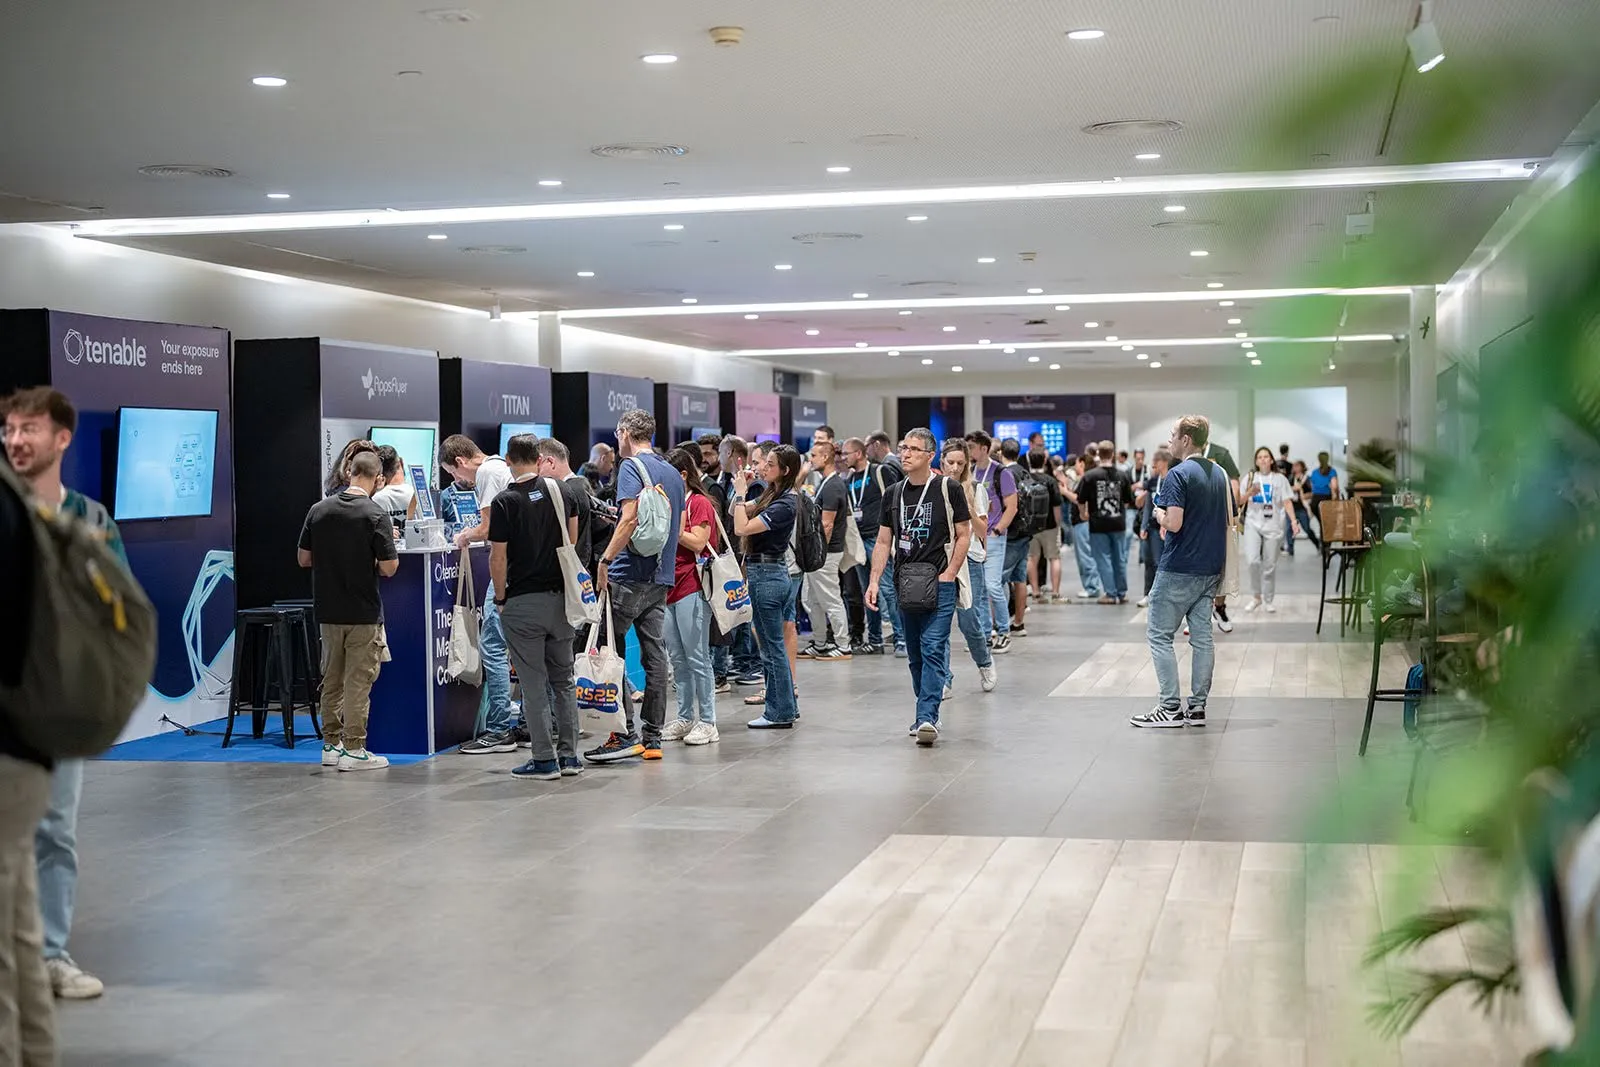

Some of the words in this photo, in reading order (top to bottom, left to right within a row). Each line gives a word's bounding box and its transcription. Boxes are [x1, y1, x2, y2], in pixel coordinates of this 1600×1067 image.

[84, 335, 147, 367] tenable
[161, 340, 180, 355] Your
[182, 345, 219, 359] exposure
[161, 361, 182, 374] ends
[184, 363, 203, 376] here
[502, 394, 530, 416] TITAN
[435, 608, 452, 629] The
[576, 686, 617, 702] RS25
